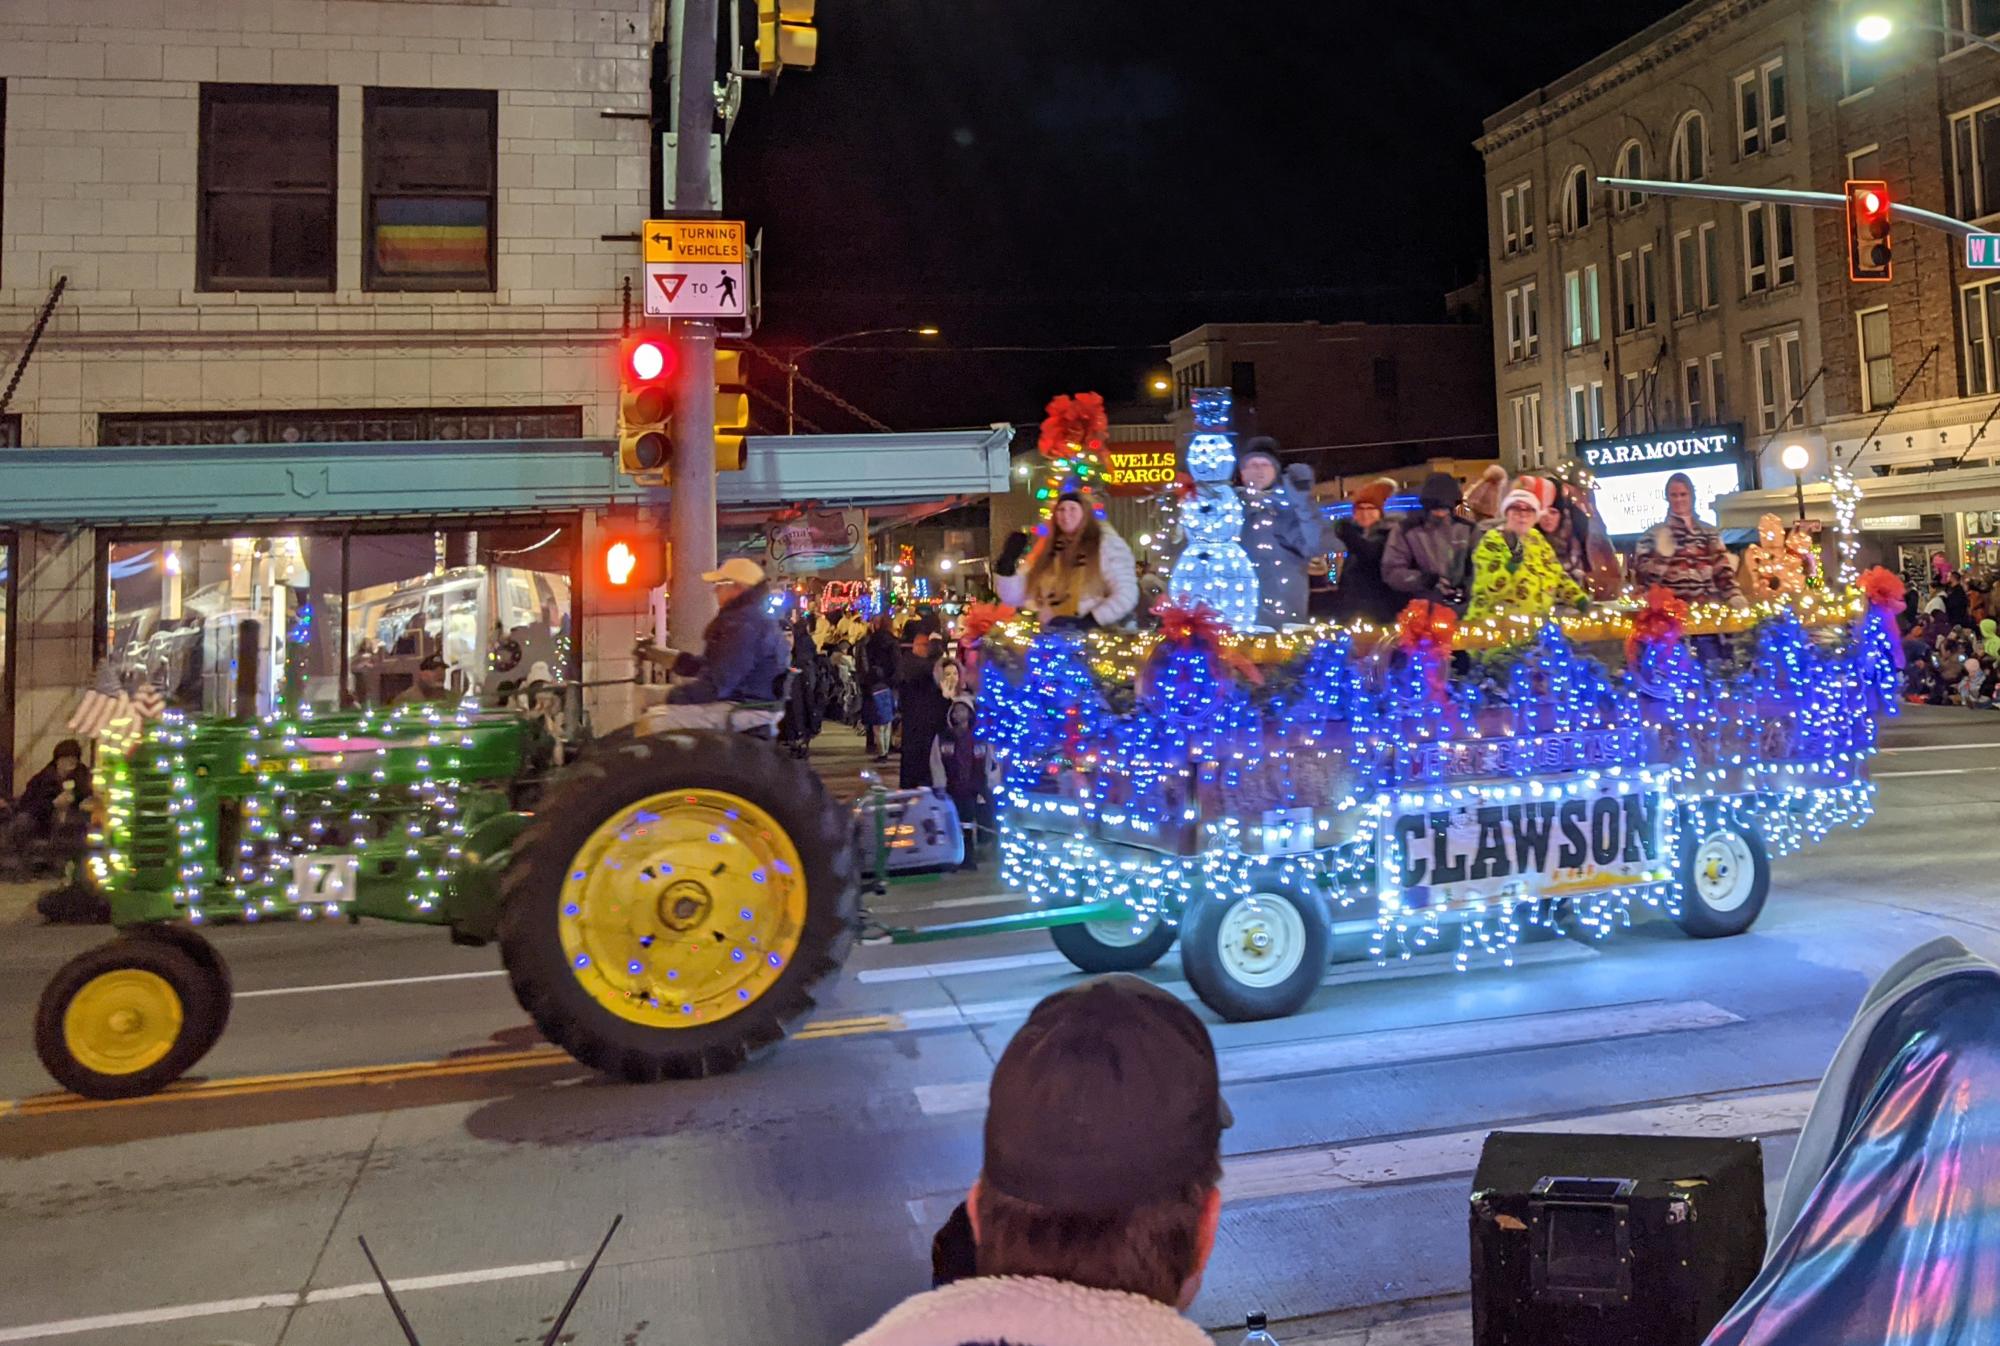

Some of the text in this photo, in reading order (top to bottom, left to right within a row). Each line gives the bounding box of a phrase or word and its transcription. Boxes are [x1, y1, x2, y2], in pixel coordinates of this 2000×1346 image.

[680, 228, 736, 239] TURNING
[679, 245, 738, 256] VEHICLES
[1970, 238, 1986, 263] W
[692, 283, 708, 294] TO
[1585, 434, 1727, 466] PARAMOUNT
[1110, 452, 1175, 468] WELLS
[1112, 468, 1175, 483] FARGO
[1396, 792, 1659, 888] CLAWSON
